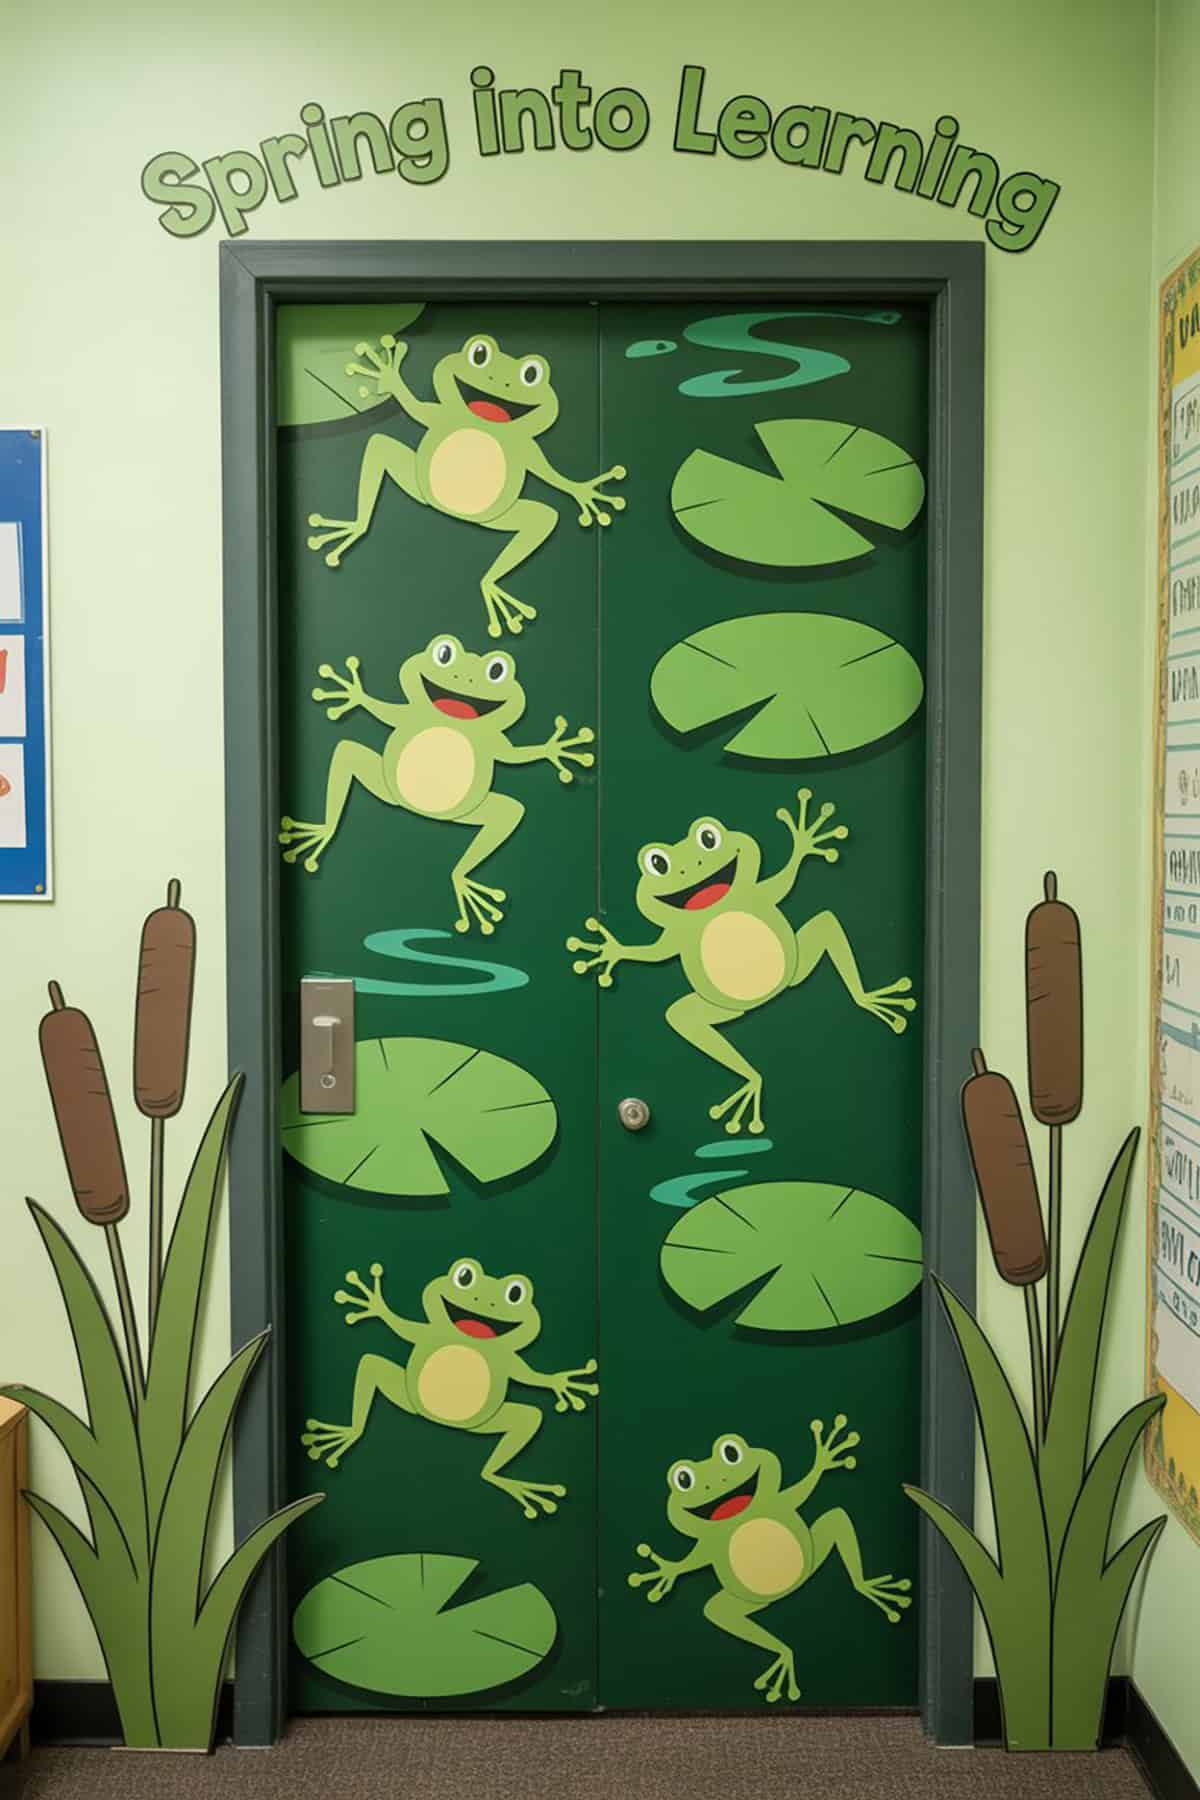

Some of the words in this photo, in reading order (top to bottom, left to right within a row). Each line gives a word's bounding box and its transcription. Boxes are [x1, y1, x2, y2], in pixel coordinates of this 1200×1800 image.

[141, 97, 450, 238] Spring
[470, 65, 650, 156] into
[673, 65, 1061, 253] Learning
